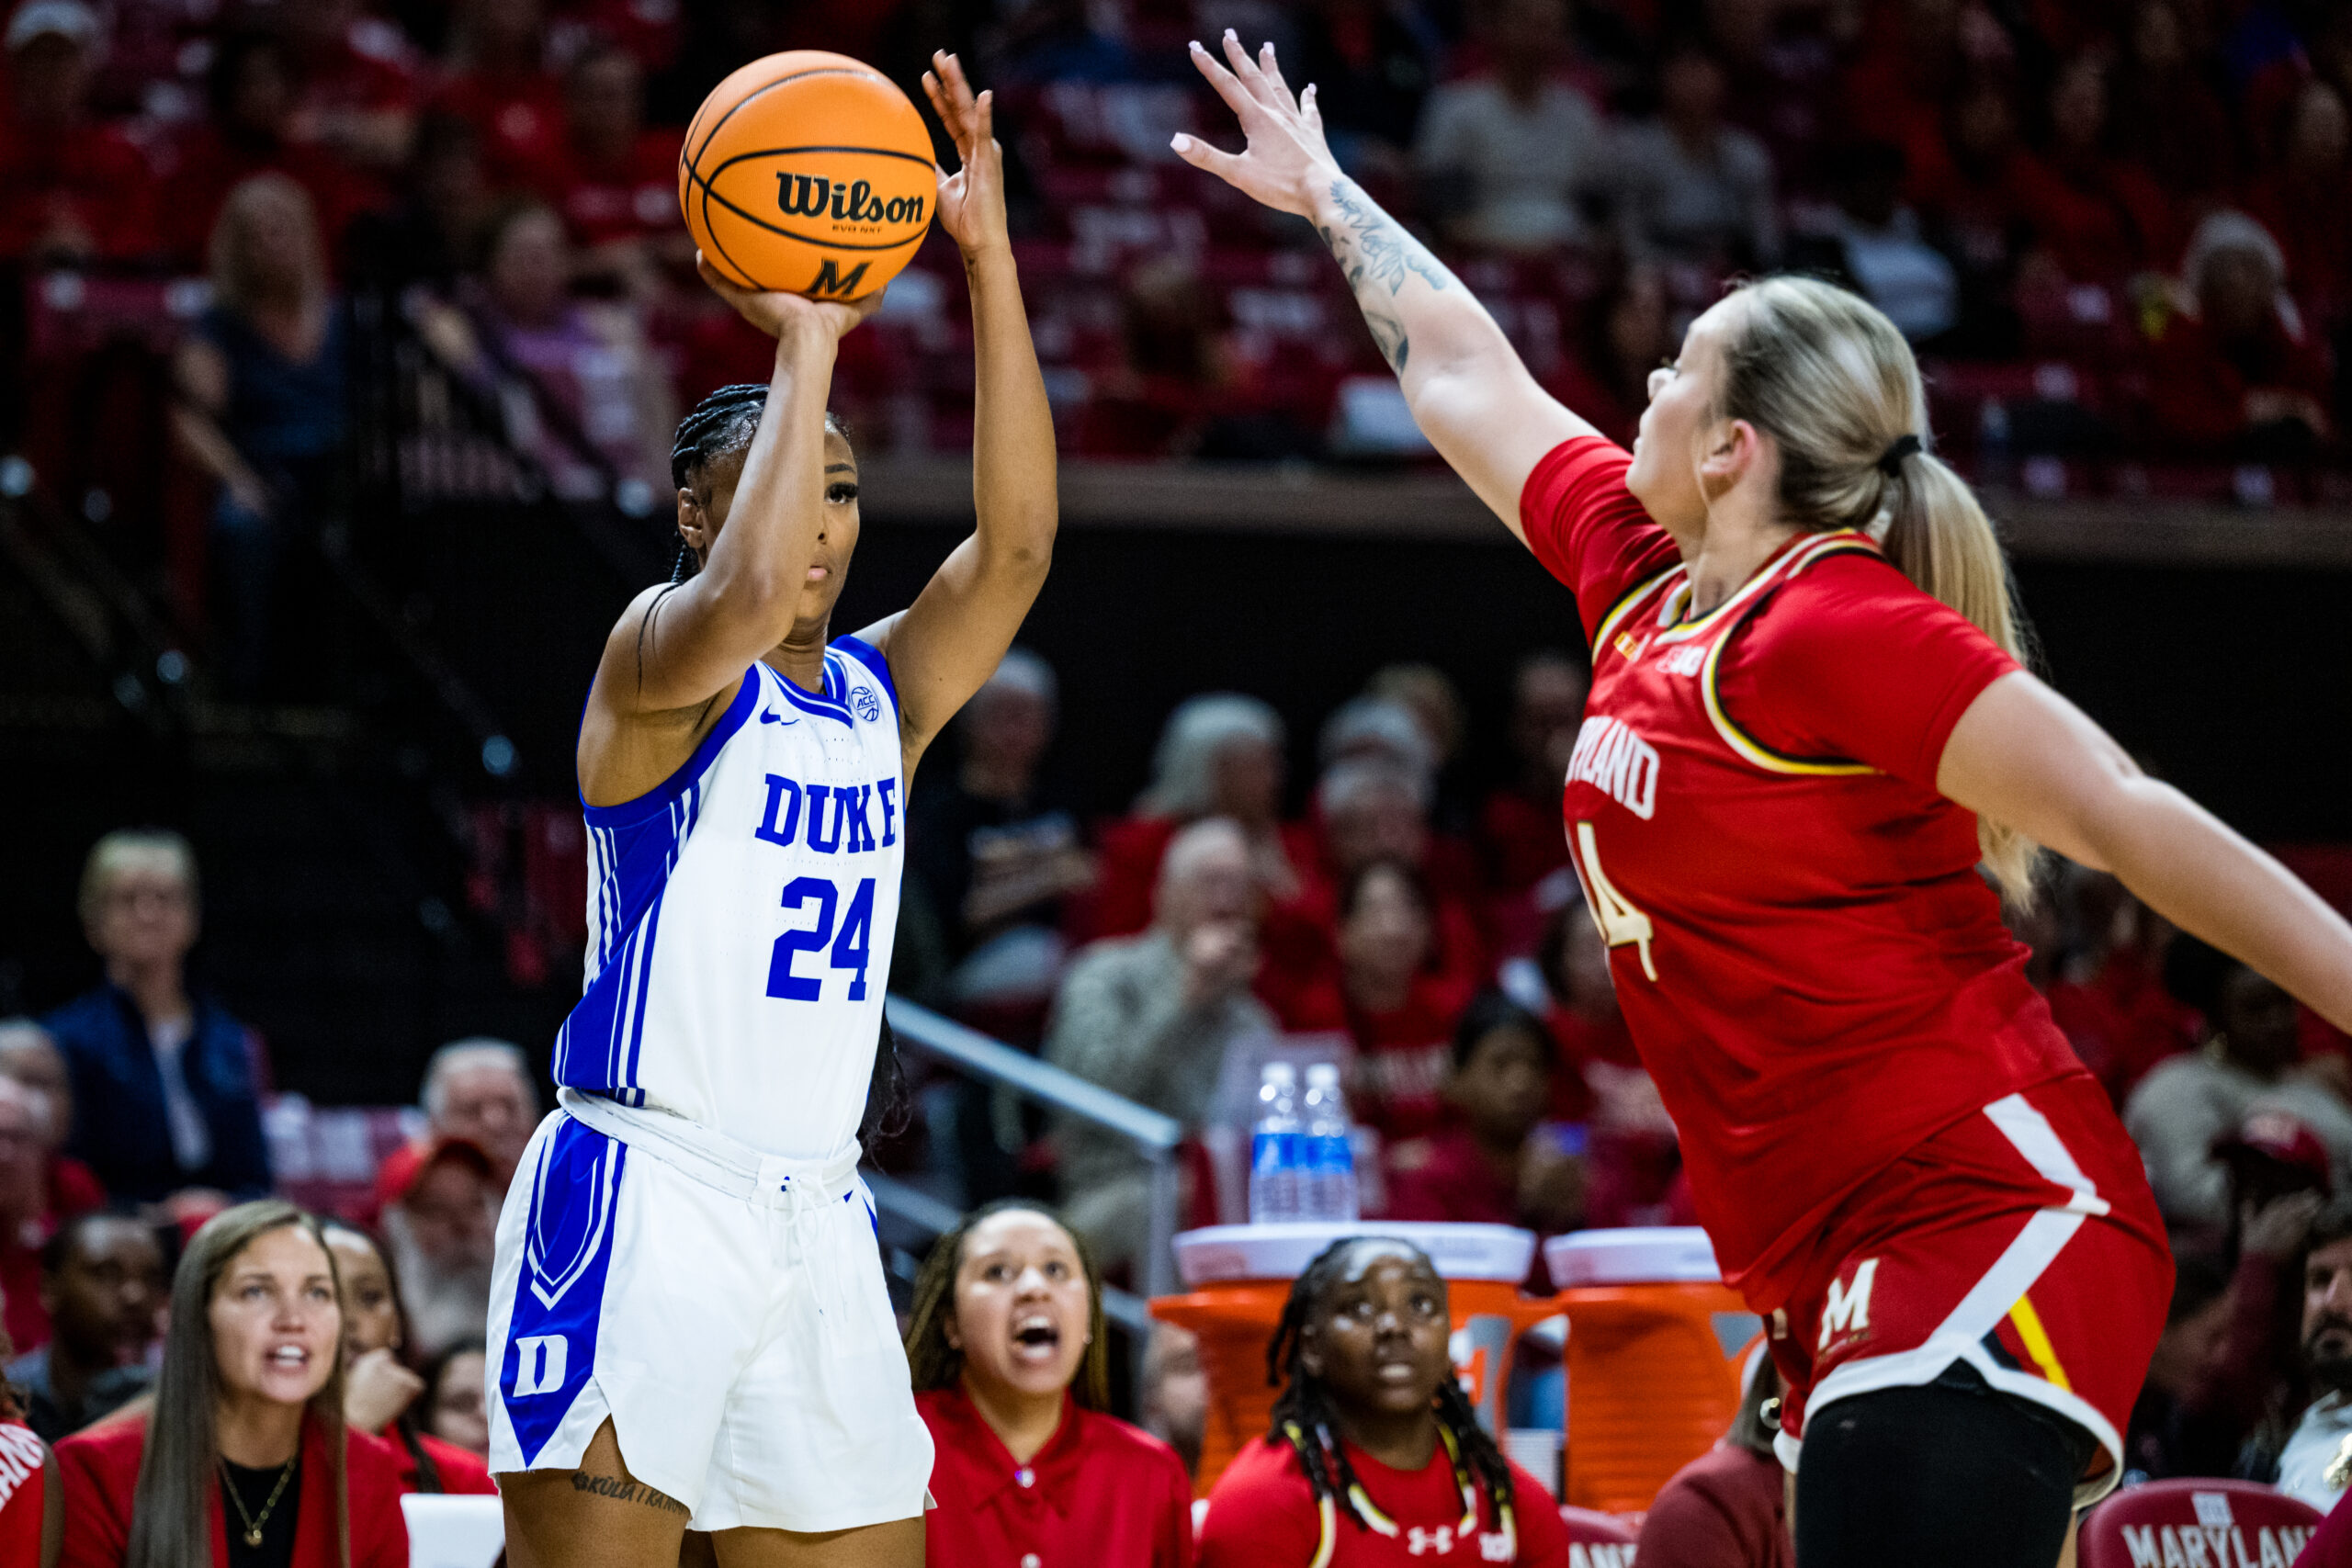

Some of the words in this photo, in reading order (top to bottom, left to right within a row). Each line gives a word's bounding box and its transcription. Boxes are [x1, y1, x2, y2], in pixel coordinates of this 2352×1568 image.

[776, 172, 923, 223] Wilson
[808, 259, 872, 295] M
[856, 694, 876, 708] ACC
[754, 773, 896, 854] DUKE
[1565, 819, 1658, 983] 4
[765, 876, 876, 1002] 24
[1818, 1258, 1880, 1351] M
[513, 1335, 569, 1398] D
[2121, 1524, 2318, 1568] MARYLAN
